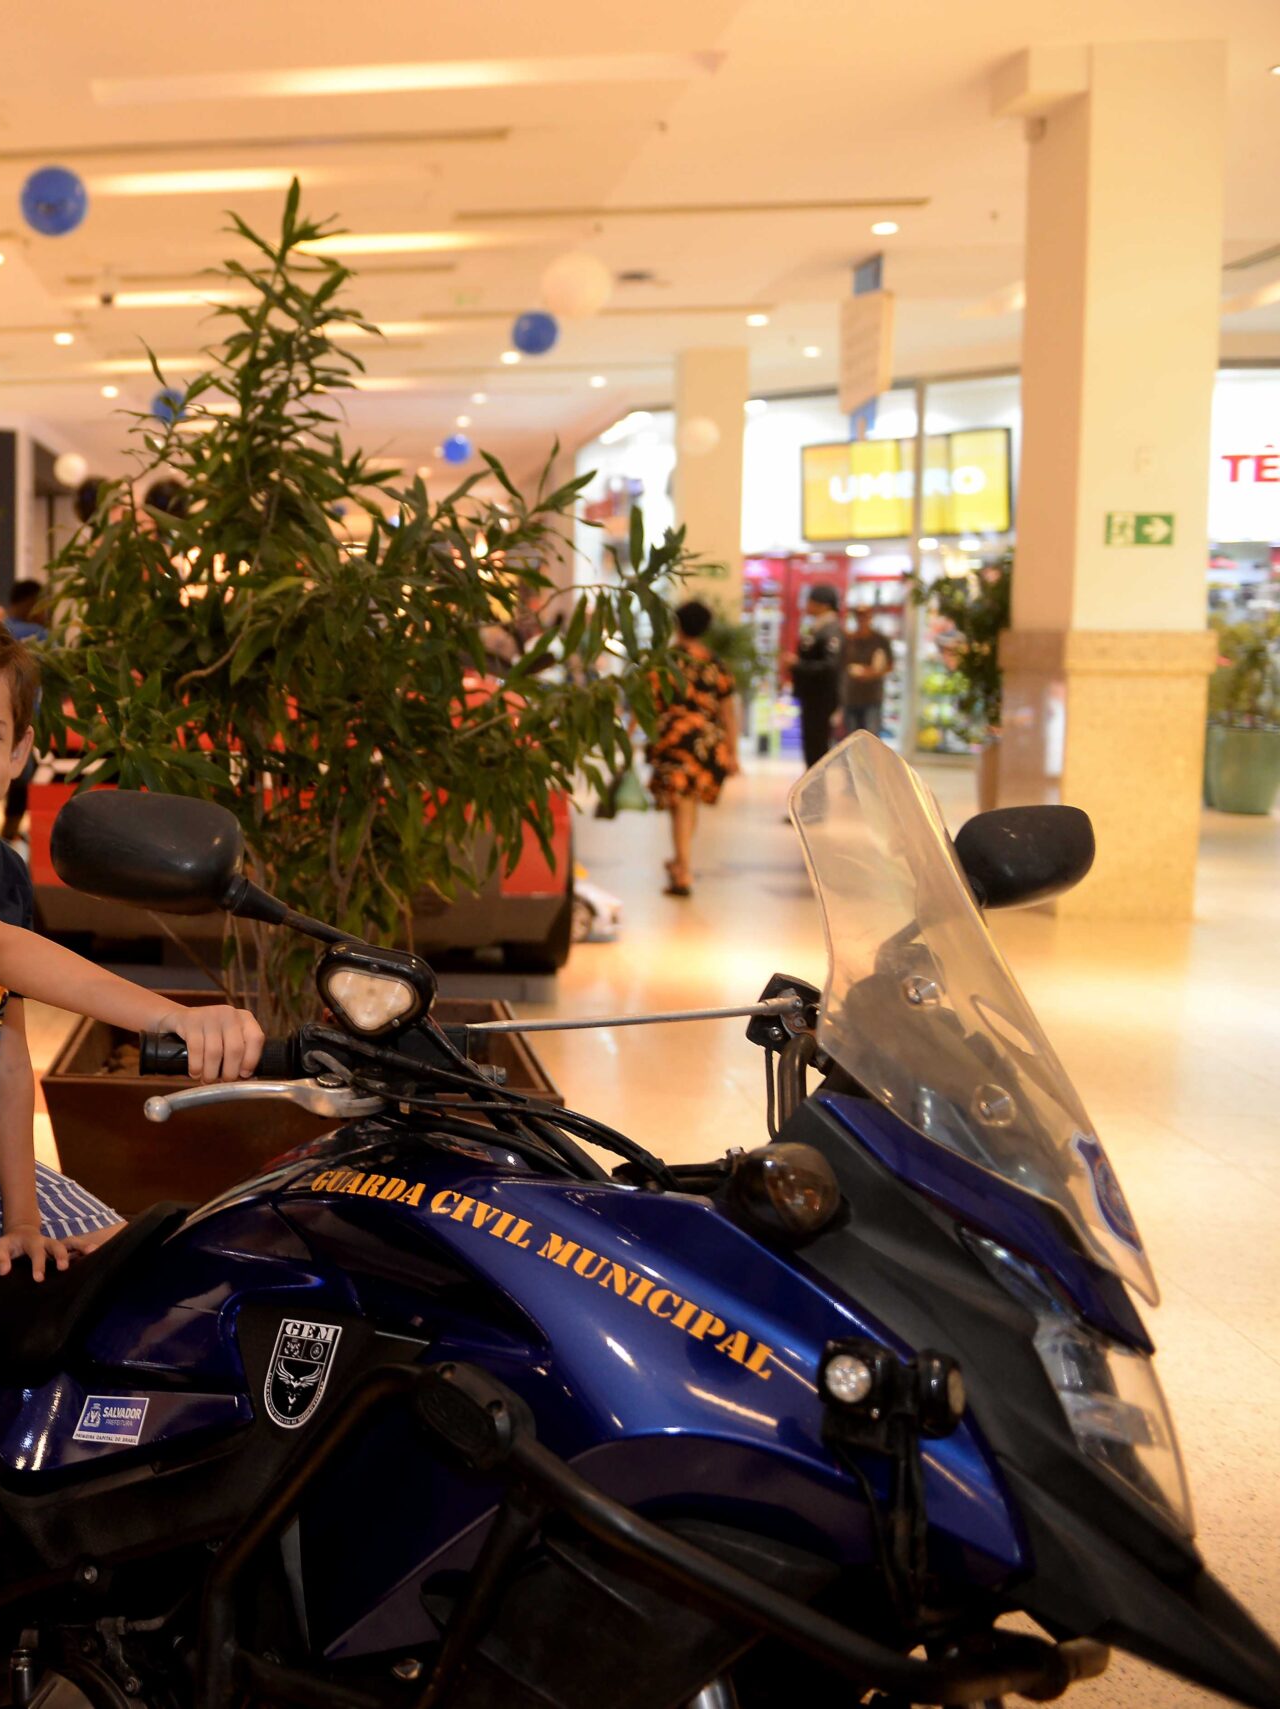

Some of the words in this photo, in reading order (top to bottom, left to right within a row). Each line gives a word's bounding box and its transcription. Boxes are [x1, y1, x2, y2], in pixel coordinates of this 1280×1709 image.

[1221, 444, 1280, 482] TÊ
[311, 1170, 426, 1207] GUARDA
[431, 1190, 533, 1249] CIVIL
[536, 1232, 774, 1380] MUNICIPAL
[285, 1322, 336, 1341] GEM
[102, 1406, 142, 1419] SALVADOR
[105, 1418, 133, 1427] PREFEITURA
